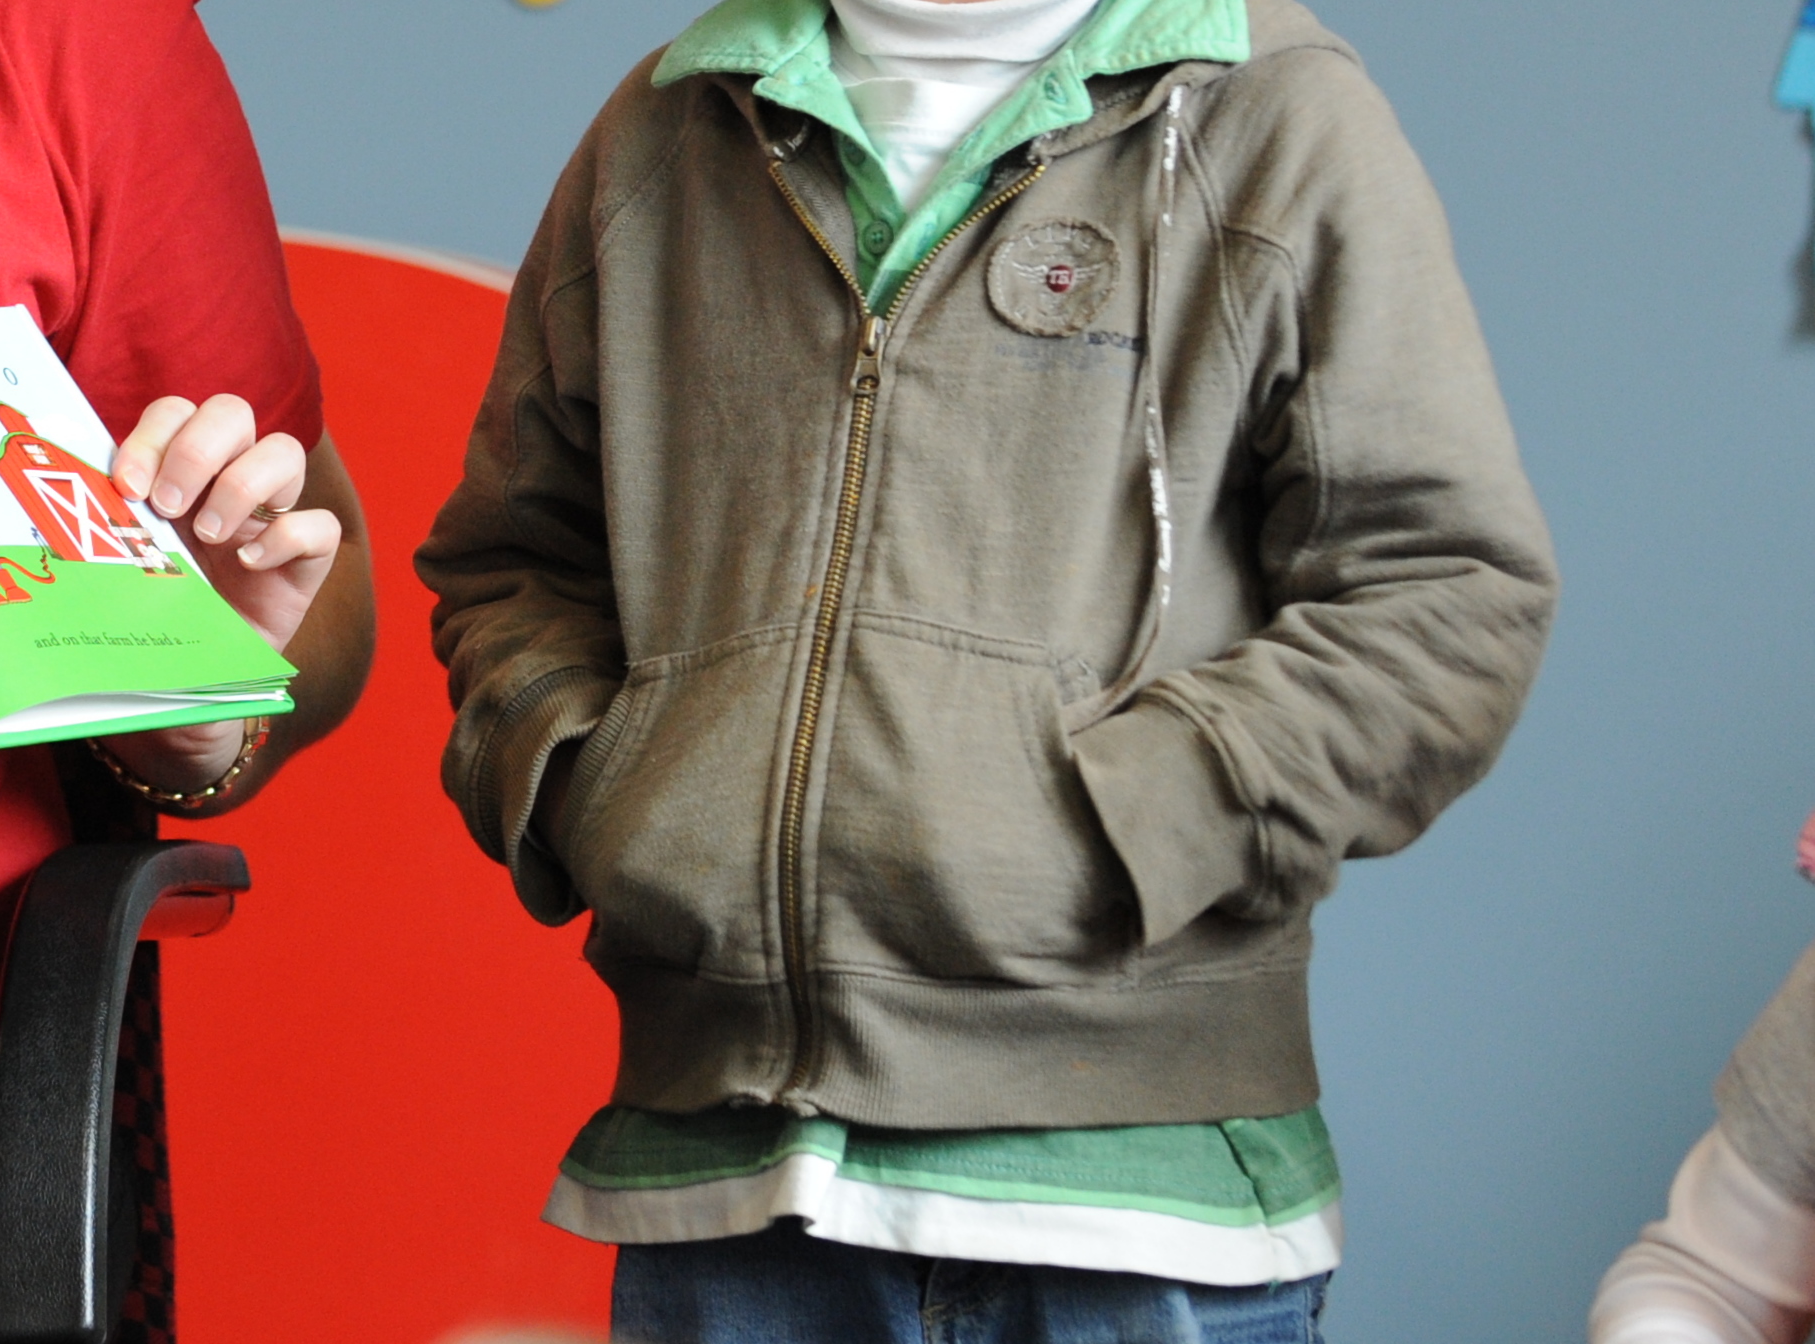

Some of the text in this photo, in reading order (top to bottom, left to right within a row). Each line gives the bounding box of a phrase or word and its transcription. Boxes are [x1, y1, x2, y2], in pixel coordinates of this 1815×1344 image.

[2, 367, 19, 387] o
[34, 631, 61, 649] and
[62, 635, 80, 646] on
[79, 630, 104, 645] that
[102, 631, 134, 646] farm
[129, 632, 150, 646] he
[145, 632, 174, 646] had
[173, 637, 184, 646] a
